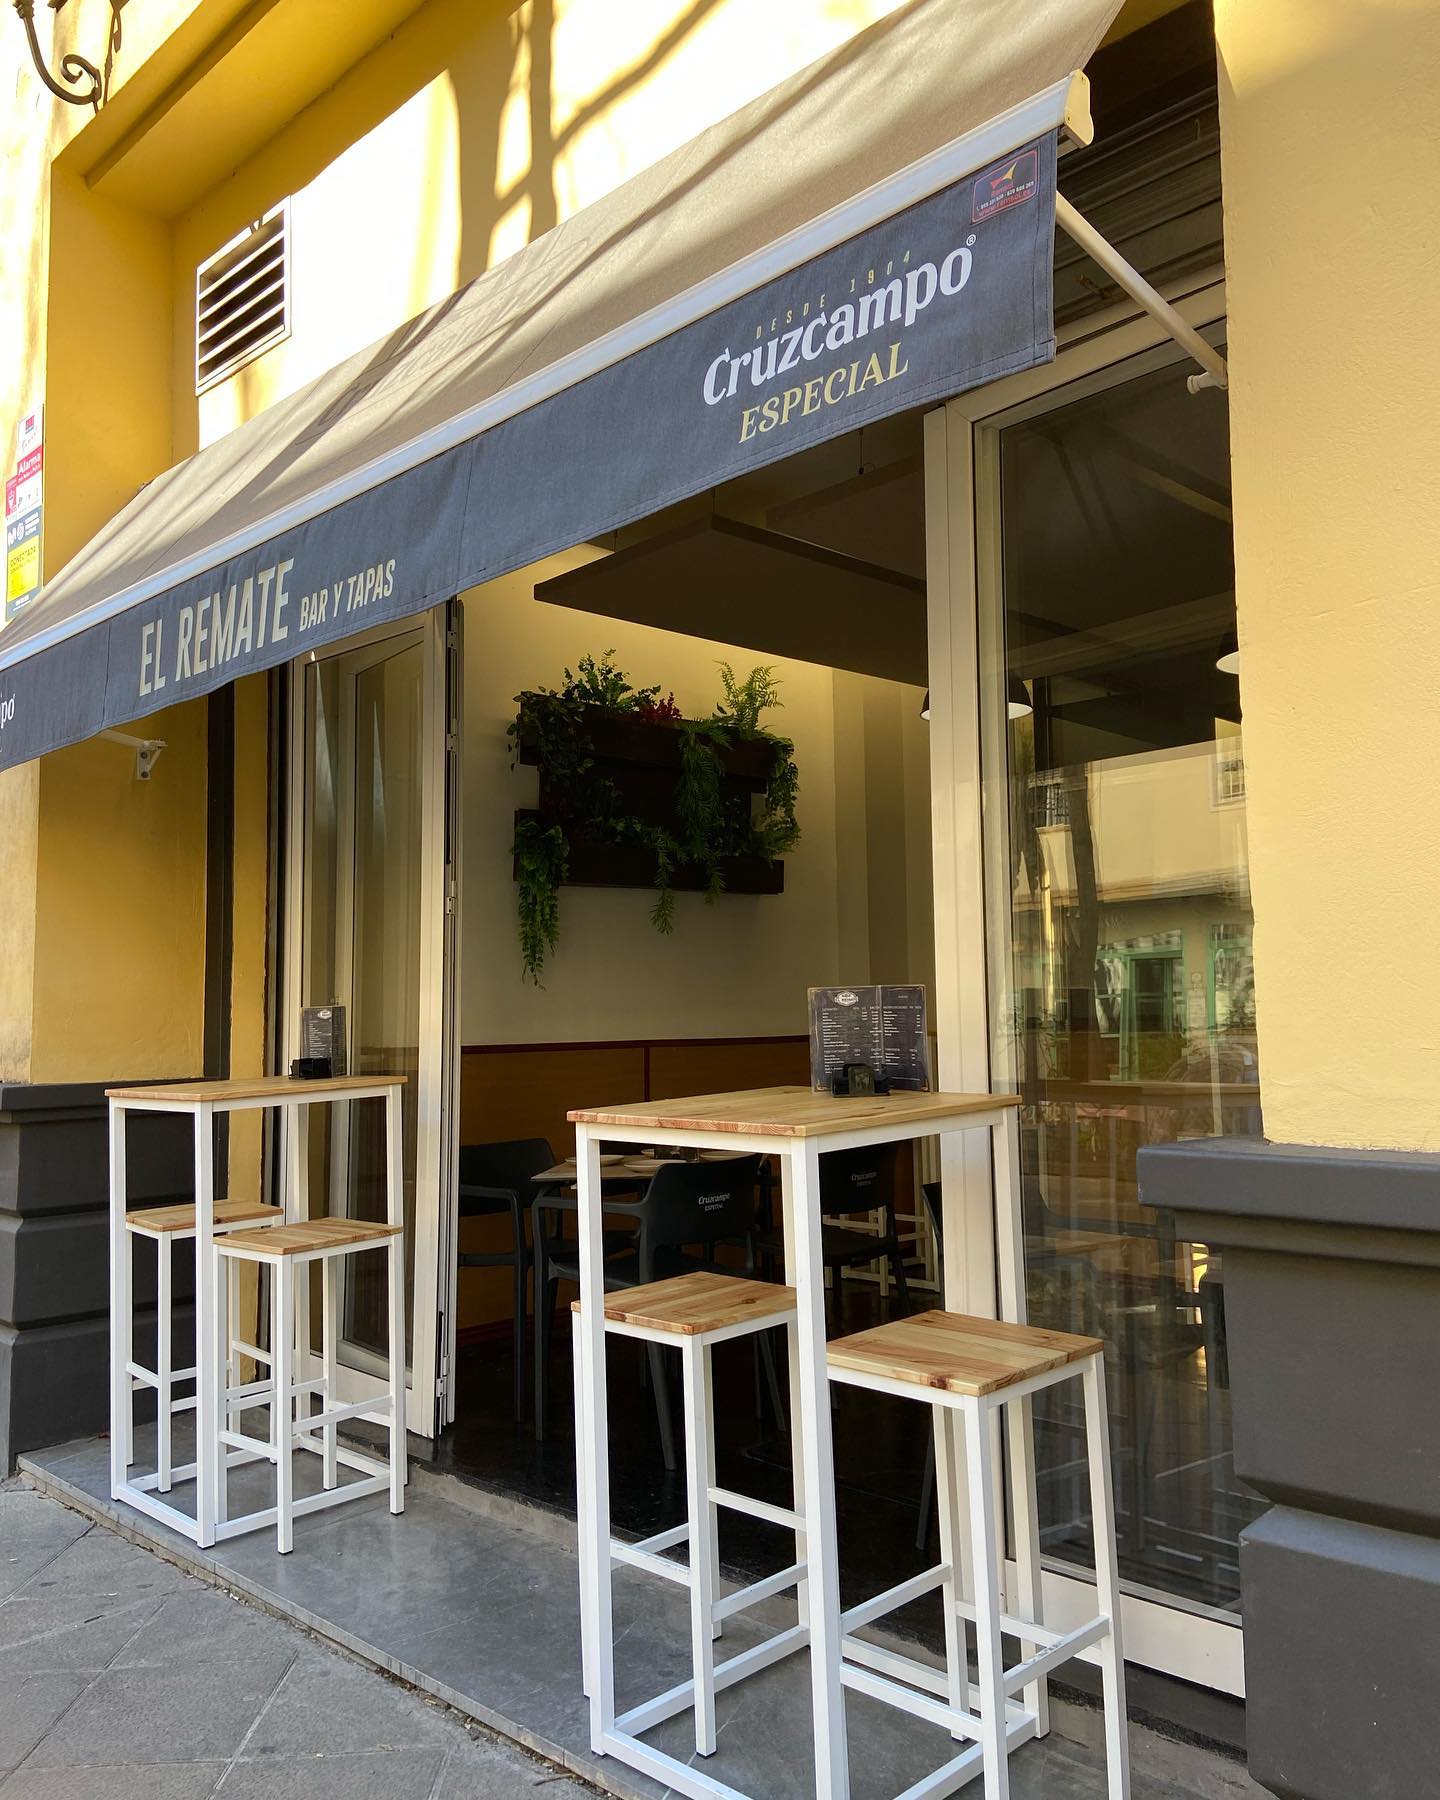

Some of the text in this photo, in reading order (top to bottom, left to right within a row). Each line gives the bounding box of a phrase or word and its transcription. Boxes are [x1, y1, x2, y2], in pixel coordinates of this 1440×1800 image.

[755, 249, 911, 339] DESDE 1904
[738, 342, 909, 443] ESPECIAL
[139, 558, 396, 697] EL REMATE BAR Y TAPAS
